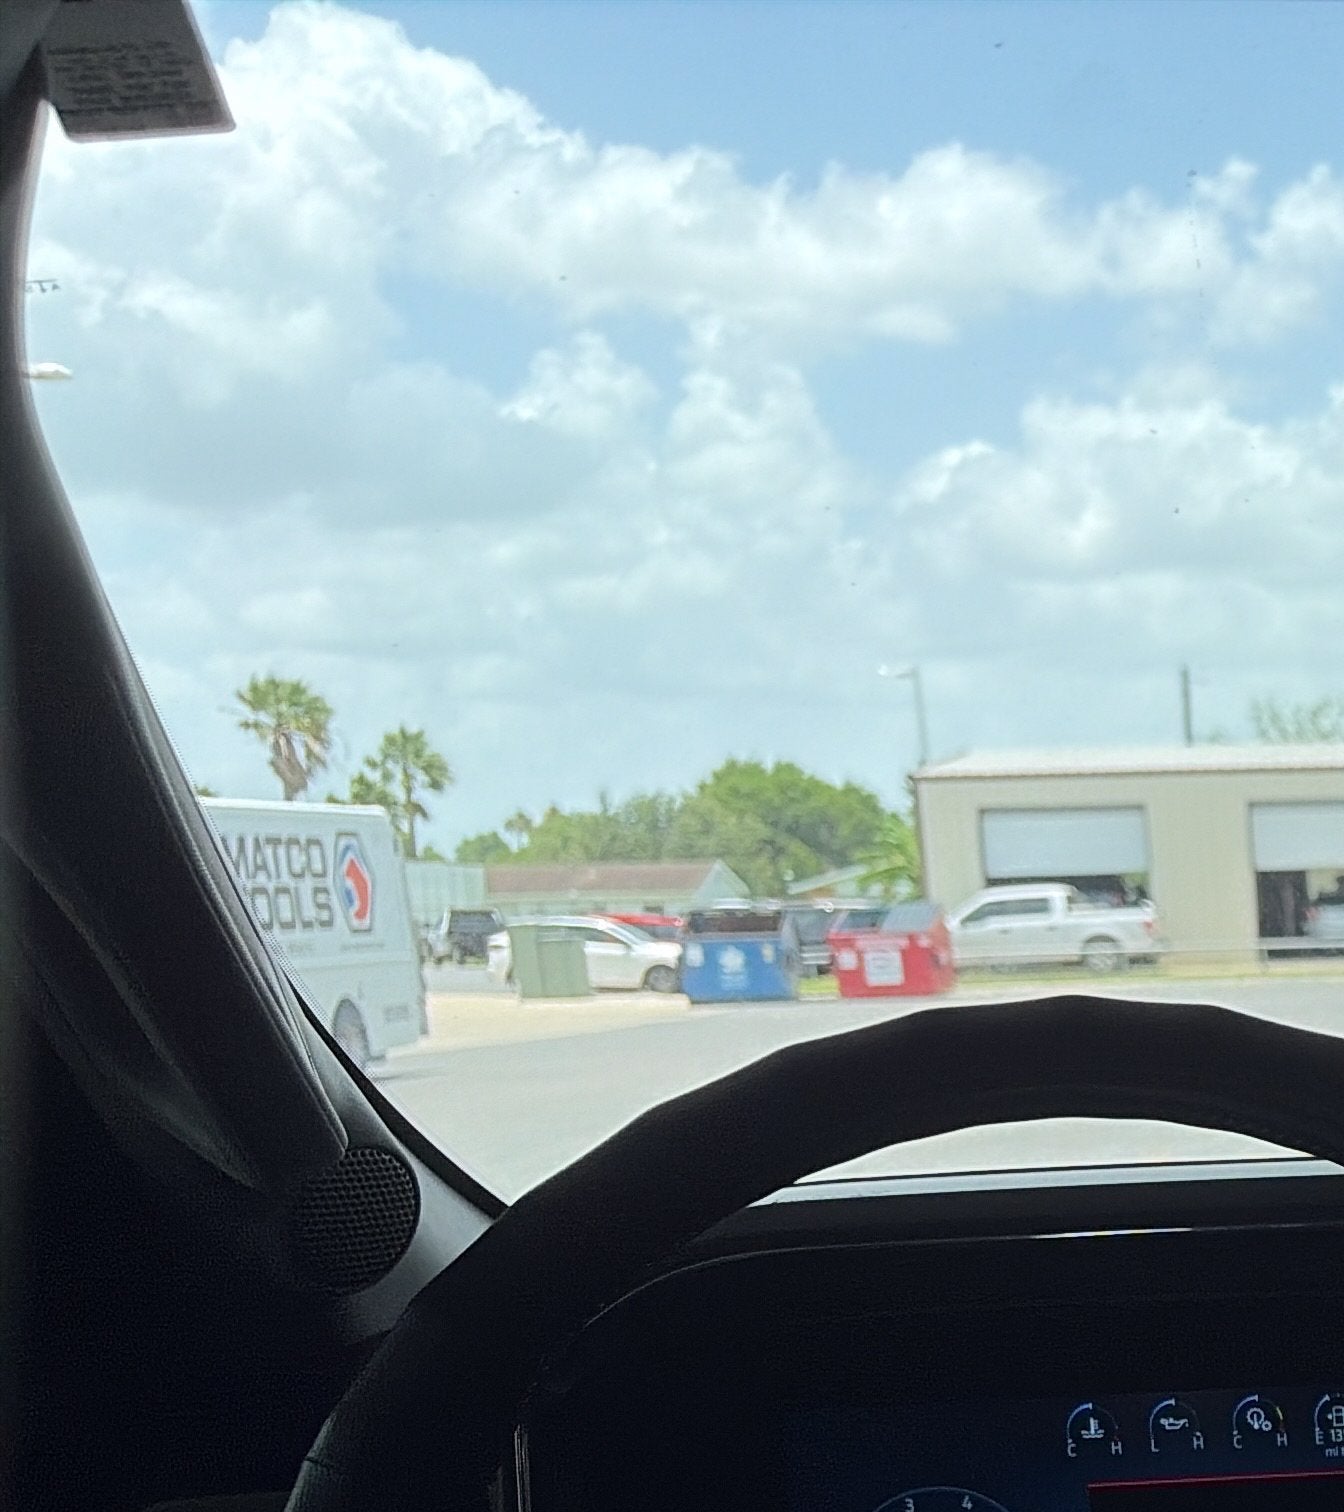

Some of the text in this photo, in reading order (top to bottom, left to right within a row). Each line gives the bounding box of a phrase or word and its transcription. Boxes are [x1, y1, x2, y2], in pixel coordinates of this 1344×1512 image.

[252, 887, 333, 930] OOLS
[1193, 1436, 1204, 1450] H
[1233, 1435, 1243, 1449] C
[1277, 1433, 1288, 1447] H
[1315, 1430, 1324, 1445] E
[1067, 1443, 1077, 1458] C
[1111, 1441, 1122, 1456] H
[1325, 1446, 1339, 1458] mi
[961, 1494, 974, 1511] 4
